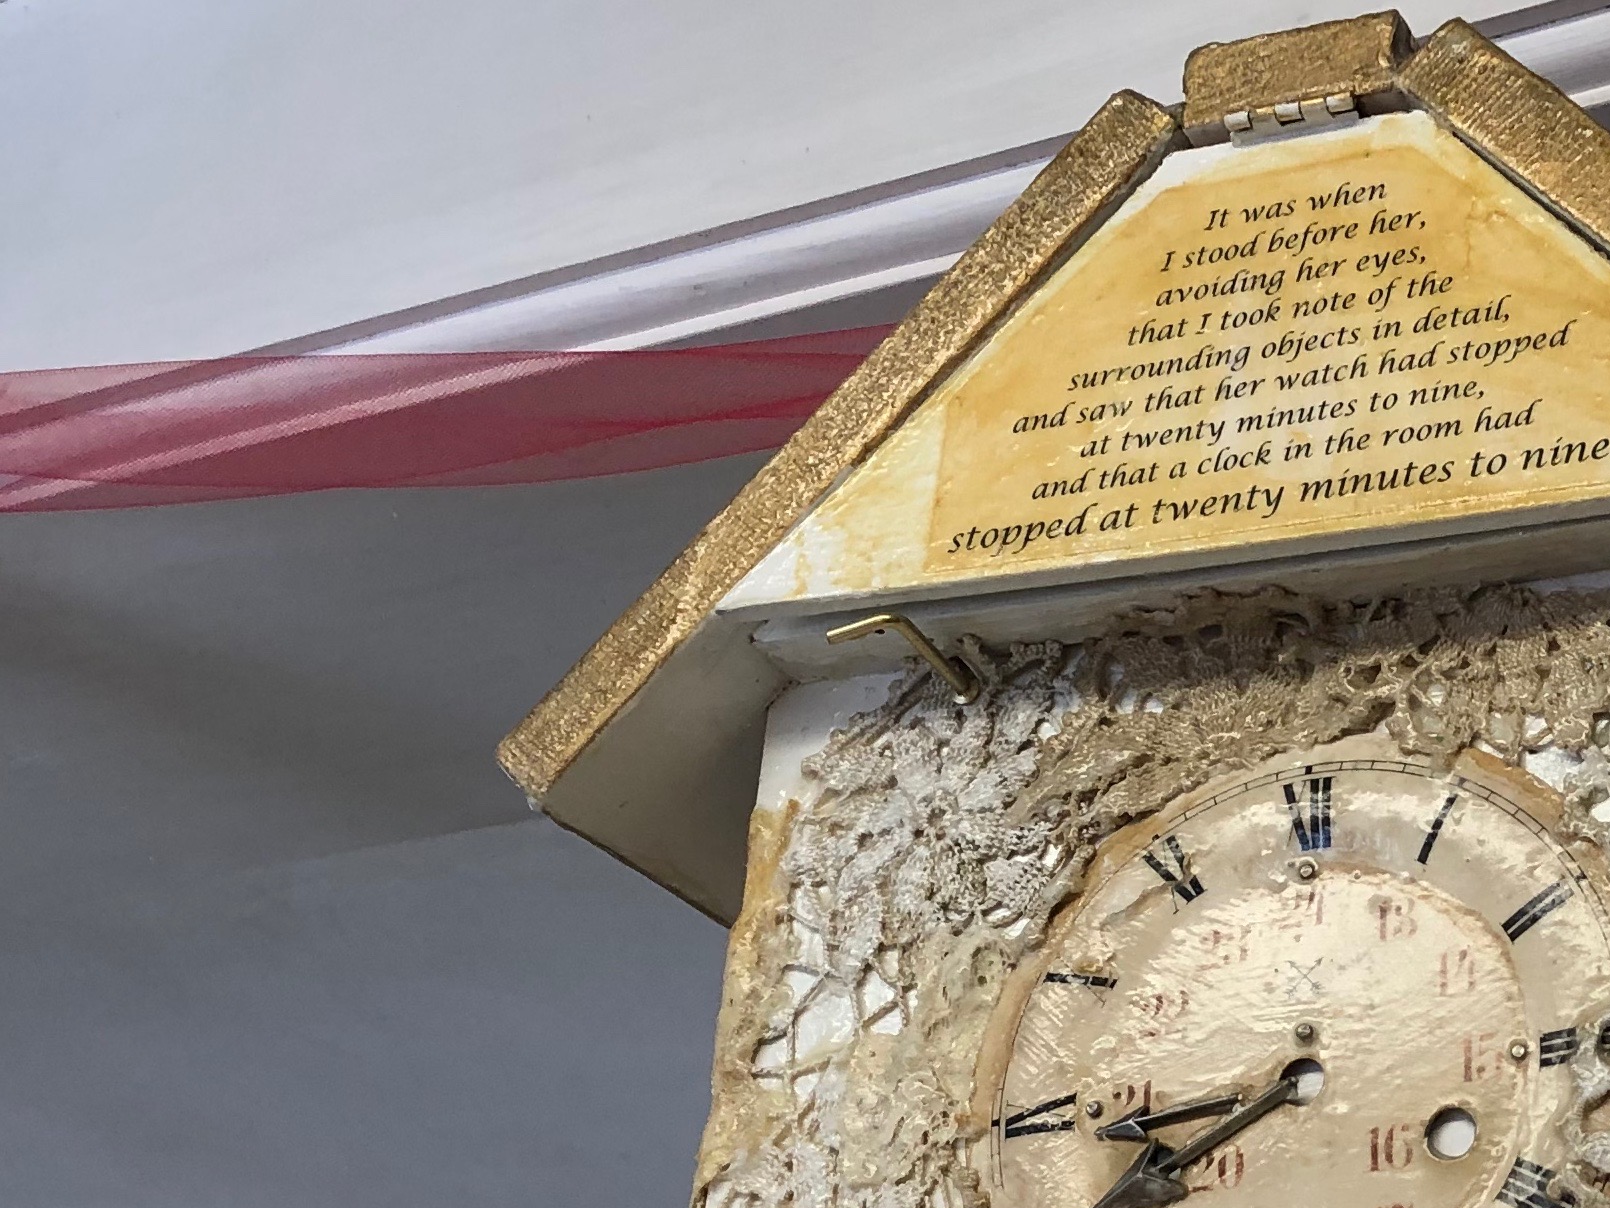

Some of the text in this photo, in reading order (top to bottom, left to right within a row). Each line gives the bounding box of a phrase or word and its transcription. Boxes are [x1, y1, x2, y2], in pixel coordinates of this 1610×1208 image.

[1160, 209, 1427, 272] I stood before her,
[1204, 182, 1387, 231] It was when
[1127, 270, 1454, 346] that I took note of the
[1156, 244, 1426, 307] avoiding her eyes,
[1012, 319, 1577, 434] and saw that her watch had stopped
[1067, 295, 1512, 391] surrounding objects in detail,
[1031, 398, 1543, 500] and that a clock in the room had
[1080, 379, 1485, 458] at twenty minutes to nine,
[948, 502, 1098, 557] stopped
[1099, 503, 1140, 531] at
[1151, 483, 1285, 524] twenty
[1299, 458, 1455, 502] minutes
[1470, 450, 1507, 478] to
[1282, 776, 1336, 851] XII
[1500, 877, 1576, 945] II
[1364, 1124, 1414, 1173] 16
